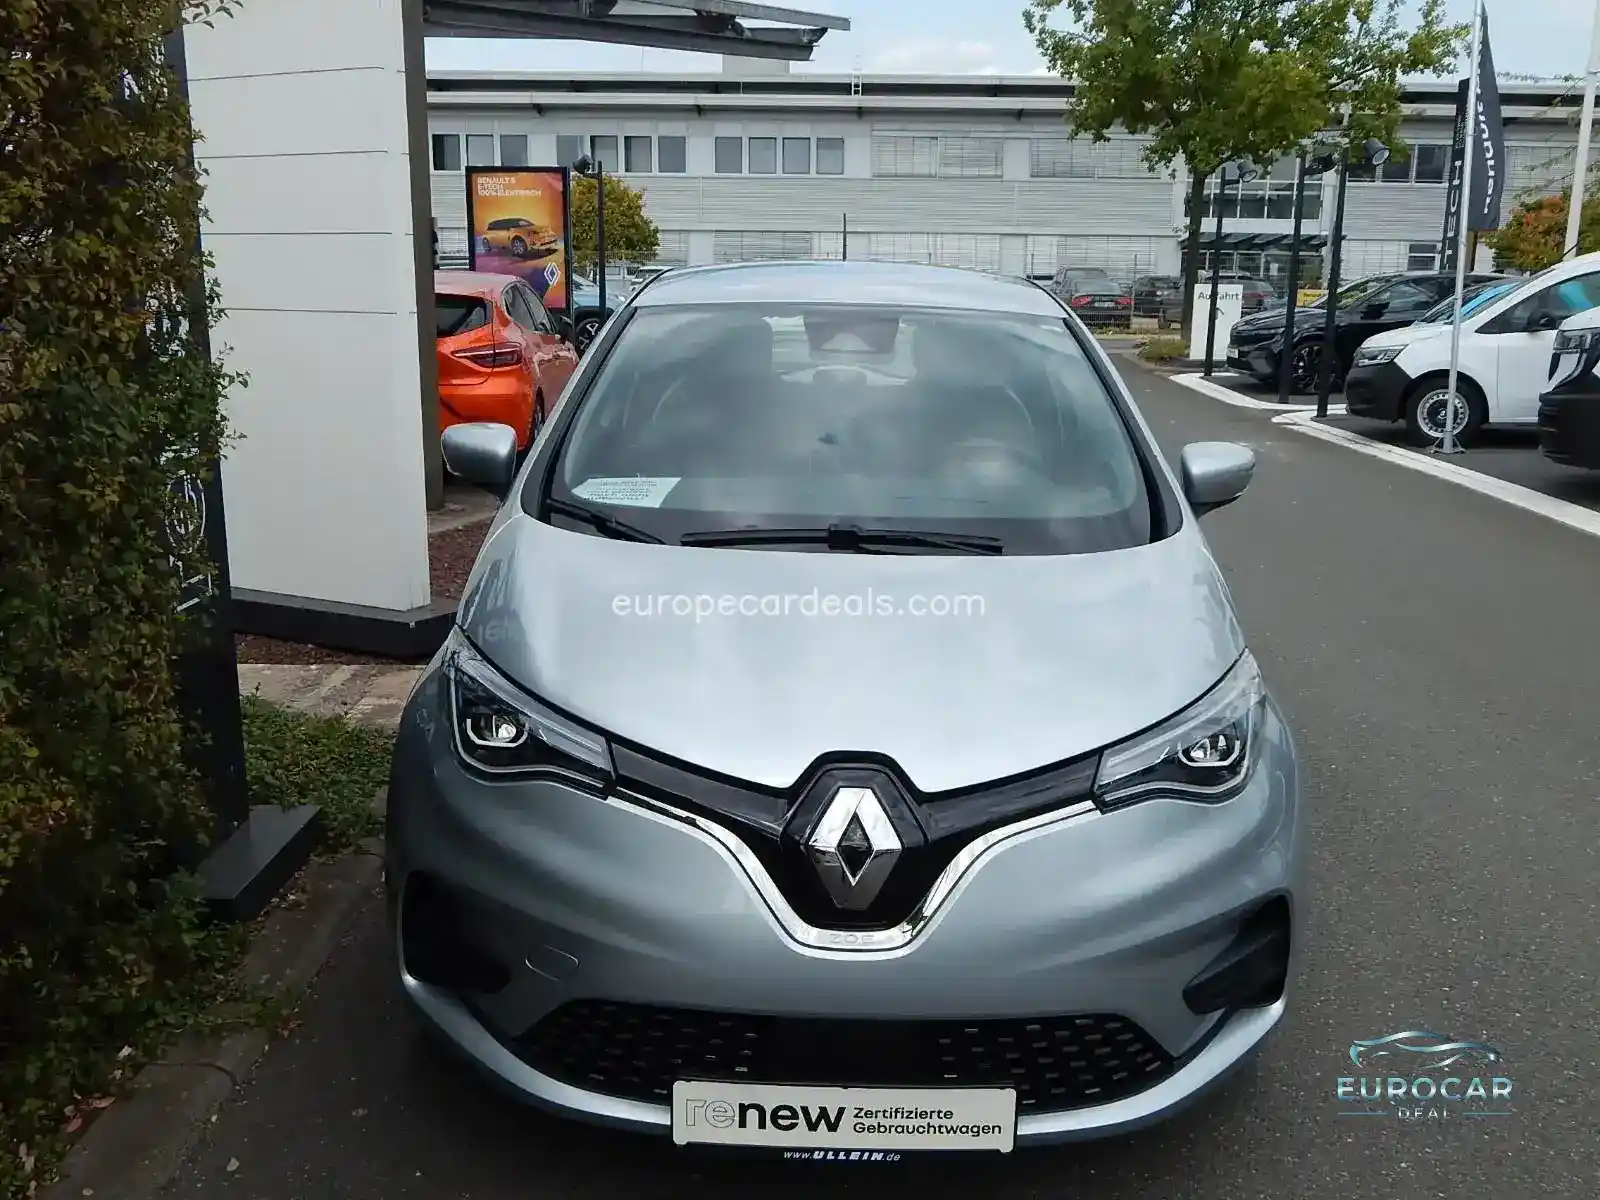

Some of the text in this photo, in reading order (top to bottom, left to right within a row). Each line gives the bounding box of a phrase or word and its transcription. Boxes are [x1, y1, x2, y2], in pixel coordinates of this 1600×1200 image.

[477, 176, 509, 184] RENAULT
[1198, 291, 1240, 300] Auahrt
[829, 933, 875, 944] ZOE
[684, 1098, 954, 1133] renew Zertifizierte
[852, 1121, 1003, 1138] Gebrauchtwagen
[783, 1150, 901, 1162] www.ULLEIN.de
